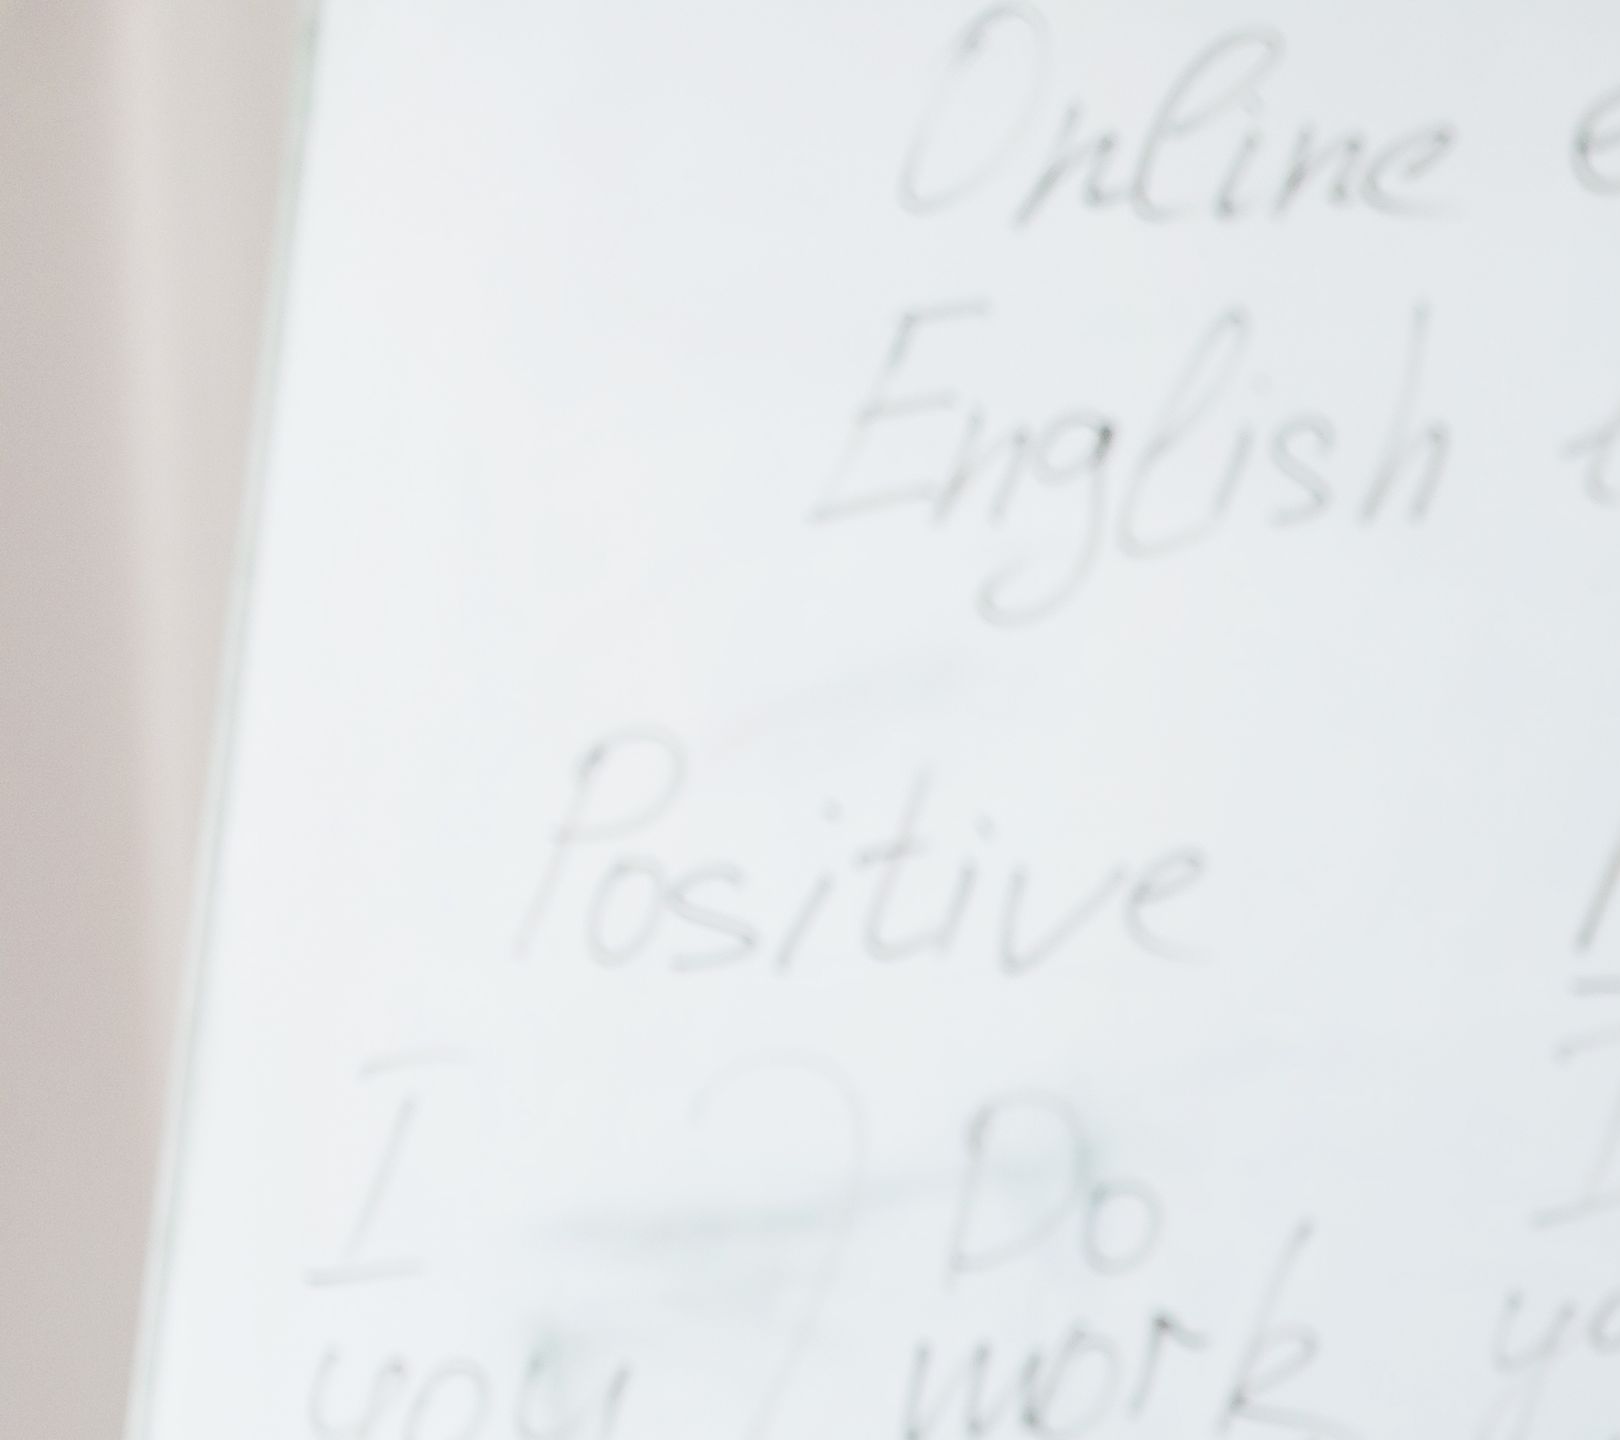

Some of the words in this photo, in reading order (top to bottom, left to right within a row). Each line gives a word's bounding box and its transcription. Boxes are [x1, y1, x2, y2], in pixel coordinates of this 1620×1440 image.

[895, 0, 1470, 232] Online
[805, 295, 1455, 628] English
[510, 722, 1214, 976] Positive
[944, 1086, 1166, 1294] Do
